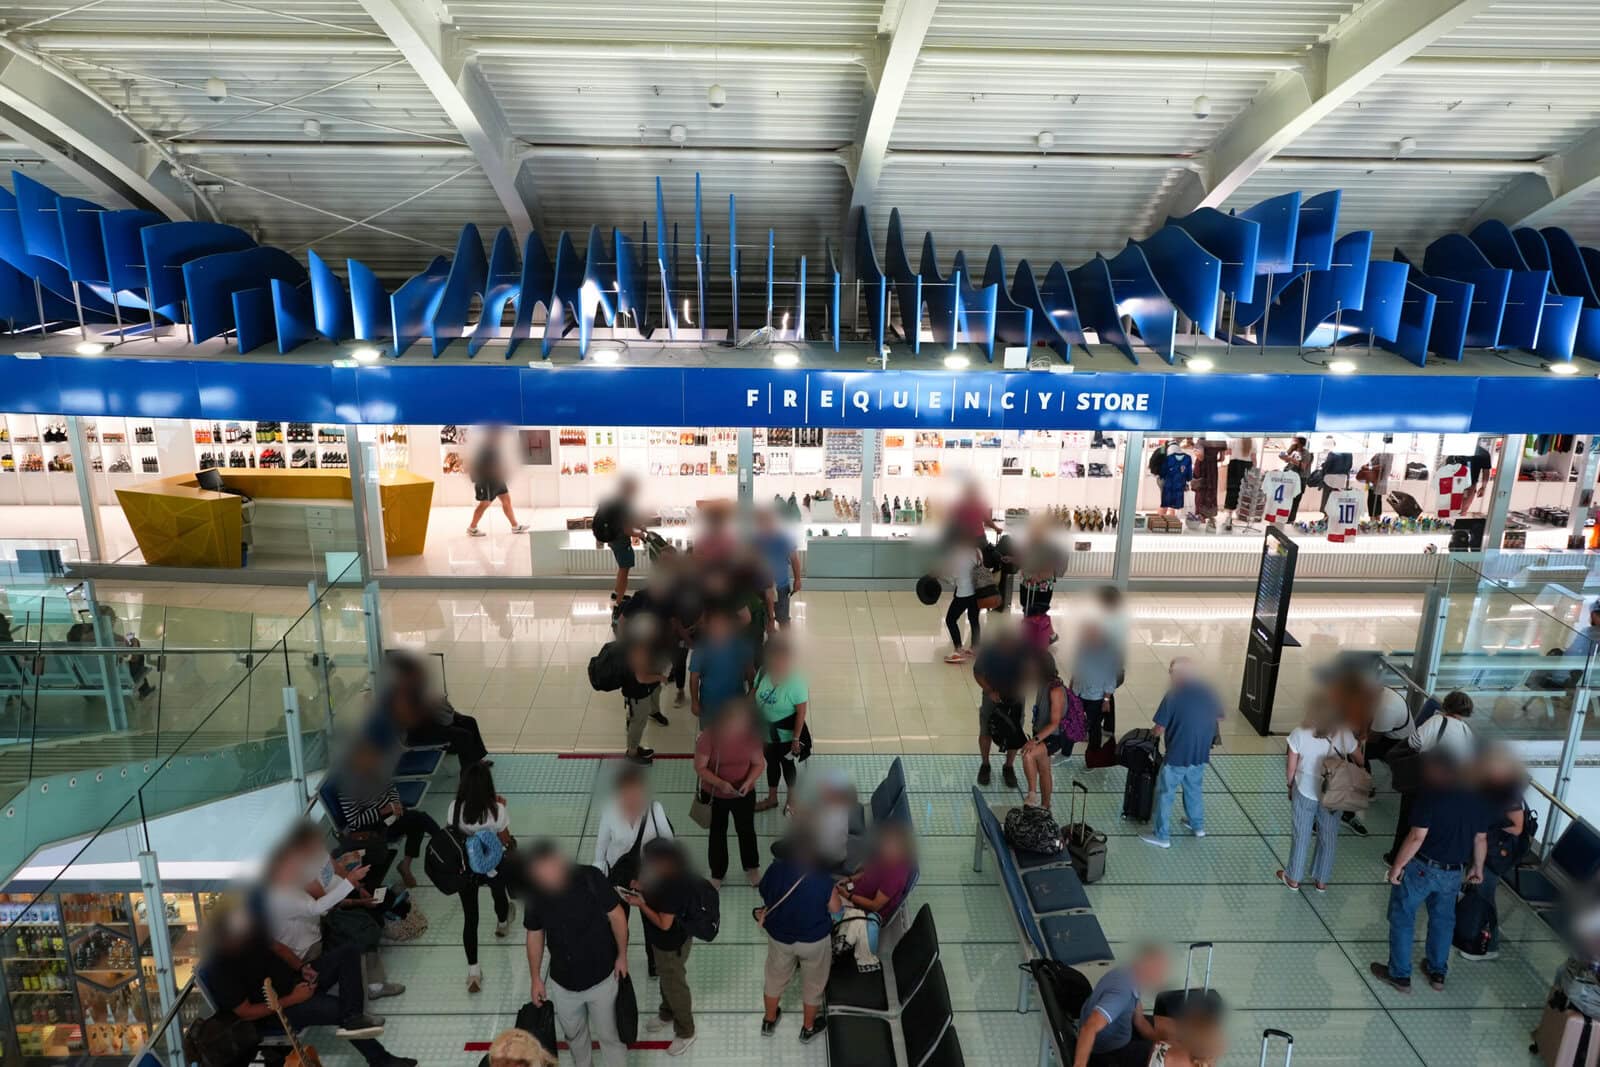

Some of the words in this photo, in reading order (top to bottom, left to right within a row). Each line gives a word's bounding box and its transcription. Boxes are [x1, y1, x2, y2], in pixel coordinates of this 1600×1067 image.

[1077, 392, 1150, 411] STORE
[1274, 484, 1285, 502] 4
[1338, 504, 1355, 524] 10
